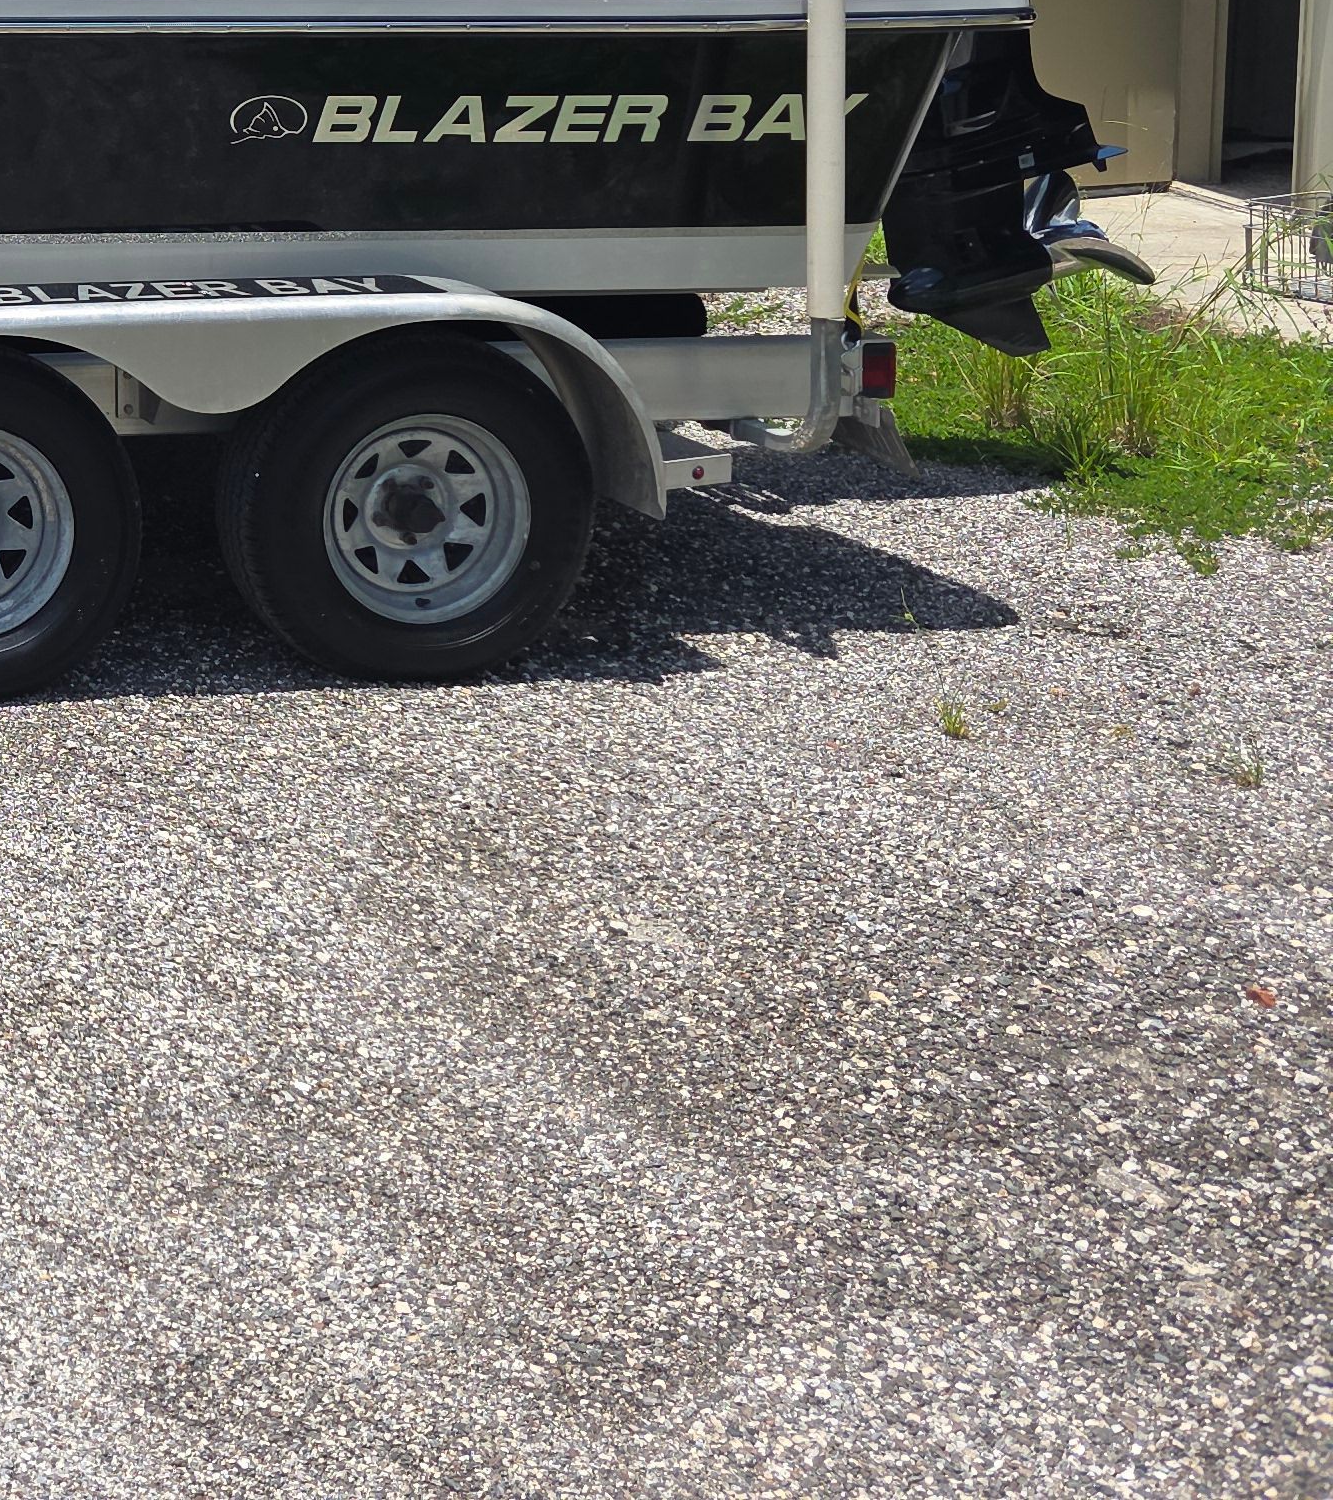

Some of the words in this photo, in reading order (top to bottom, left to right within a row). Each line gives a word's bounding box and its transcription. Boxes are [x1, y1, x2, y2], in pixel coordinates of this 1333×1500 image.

[311, 94, 669, 143] BLAZER
[686, 93, 870, 142] BA
[253, 276, 384, 296] BAY
